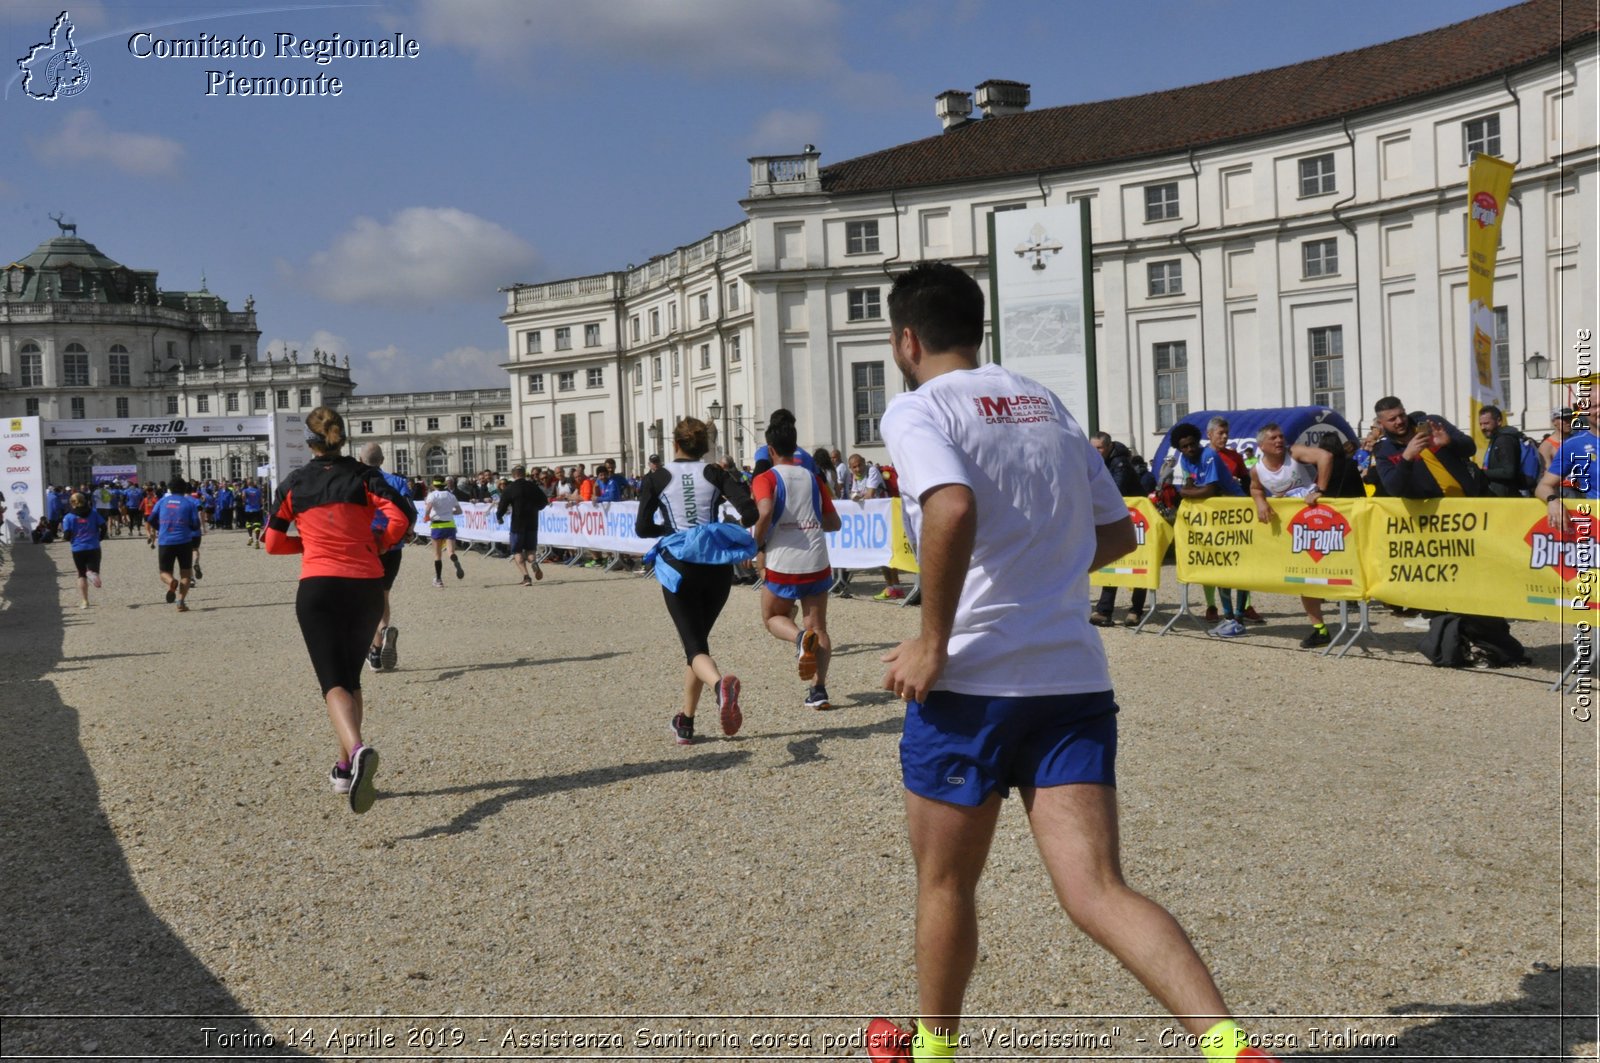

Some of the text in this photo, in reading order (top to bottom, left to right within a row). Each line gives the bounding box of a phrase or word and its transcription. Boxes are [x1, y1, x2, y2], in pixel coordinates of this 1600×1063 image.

[980, 396, 1049, 417] MUSSO
[985, 416, 1049, 425] CASTELLAMONTE
[681, 473, 697, 526] ARUNNER
[568, 511, 605, 537] TOYOTA
[606, 512, 638, 538] HYBRI
[1183, 508, 1254, 527] HAI PRESO
[1387, 512, 1489, 534] HAI PRESO I
[1292, 523, 1345, 556] Biraghi
[1389, 538, 1475, 558] BIRAGHINI
[1187, 550, 1240, 567] SNACK?
[1389, 564, 1459, 583] SNACK?
